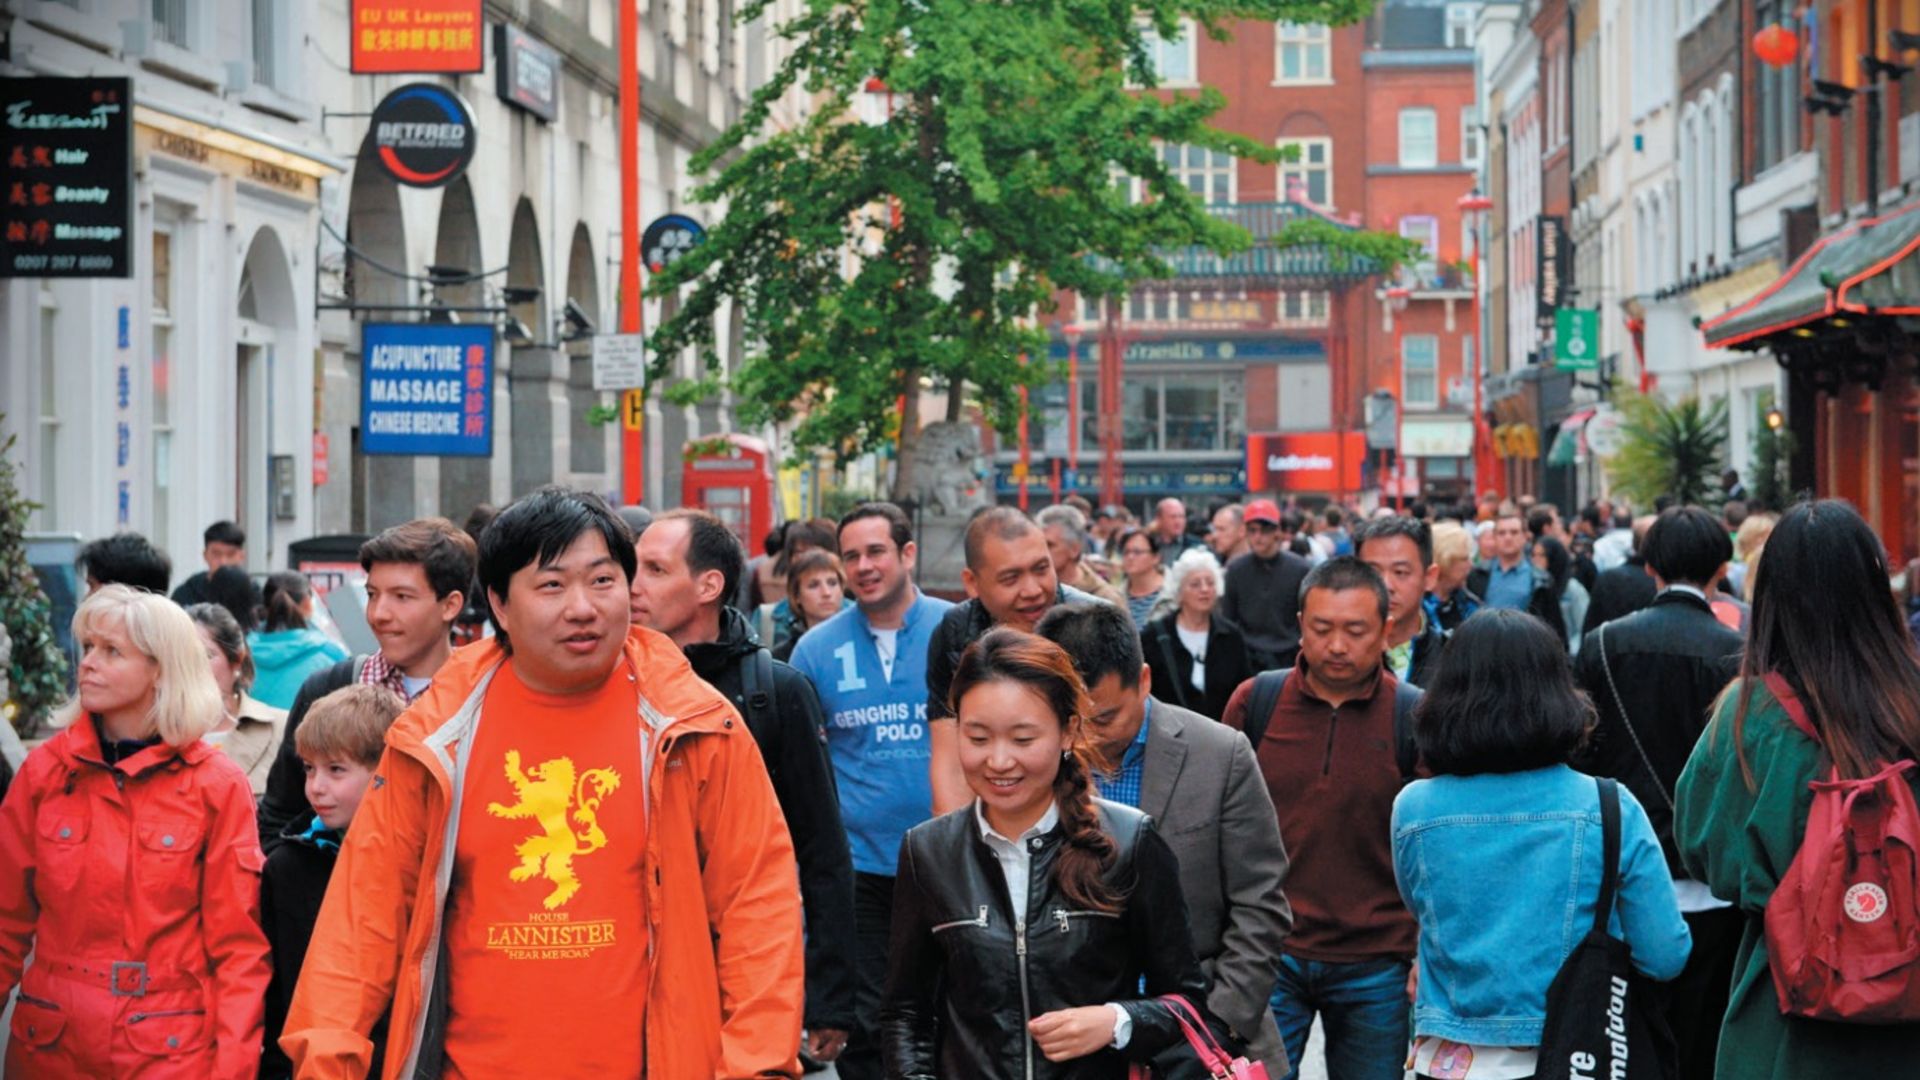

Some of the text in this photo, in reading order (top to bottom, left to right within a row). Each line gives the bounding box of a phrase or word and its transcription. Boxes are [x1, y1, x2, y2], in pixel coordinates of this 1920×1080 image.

[360, 9, 474, 25] EU UK Lawyers
[377, 122, 465, 140] BETFRED
[54, 149, 89, 165] Hair
[54, 186, 110, 205] Beauty
[54, 223, 122, 241] Massage
[370, 345, 462, 371] ACUPUNCTURE
[369, 379, 462, 403] MASSAGE
[369, 410, 460, 436] CHINESE MEDICINE
[833, 640, 867, 693] 1
[834, 703, 929, 729] GENGHIS K
[875, 723, 923, 743] POLO
[528, 912, 570, 923] HOUSE
[487, 923, 617, 946] LANNISTER
[541, 948, 560, 960] ME
[1605, 975, 1629, 1080] mpidou
[1569, 1051, 1597, 1080] re
